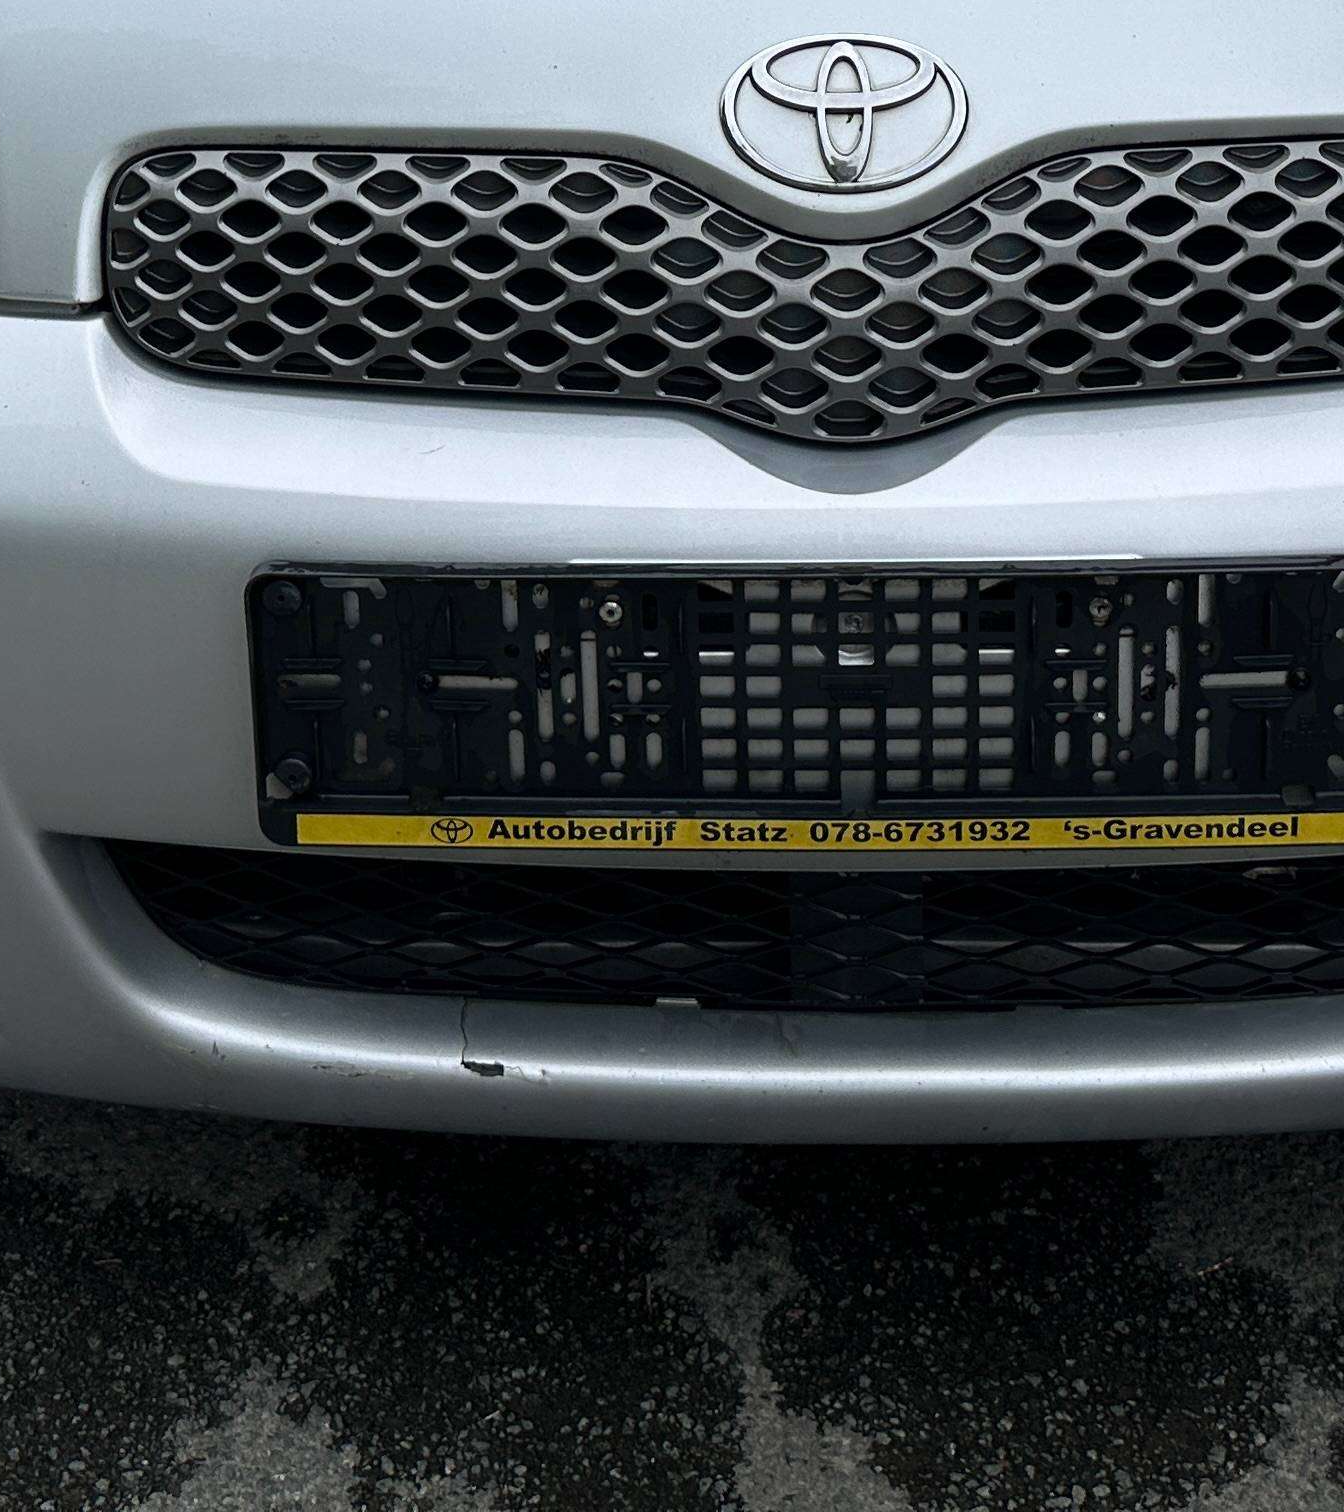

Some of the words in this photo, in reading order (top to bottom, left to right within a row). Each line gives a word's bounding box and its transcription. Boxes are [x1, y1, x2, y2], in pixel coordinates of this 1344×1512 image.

[487, 818, 677, 847] Autobedrijf
[700, 821, 789, 843] Statz
[809, 821, 1031, 843] 078-6731932
